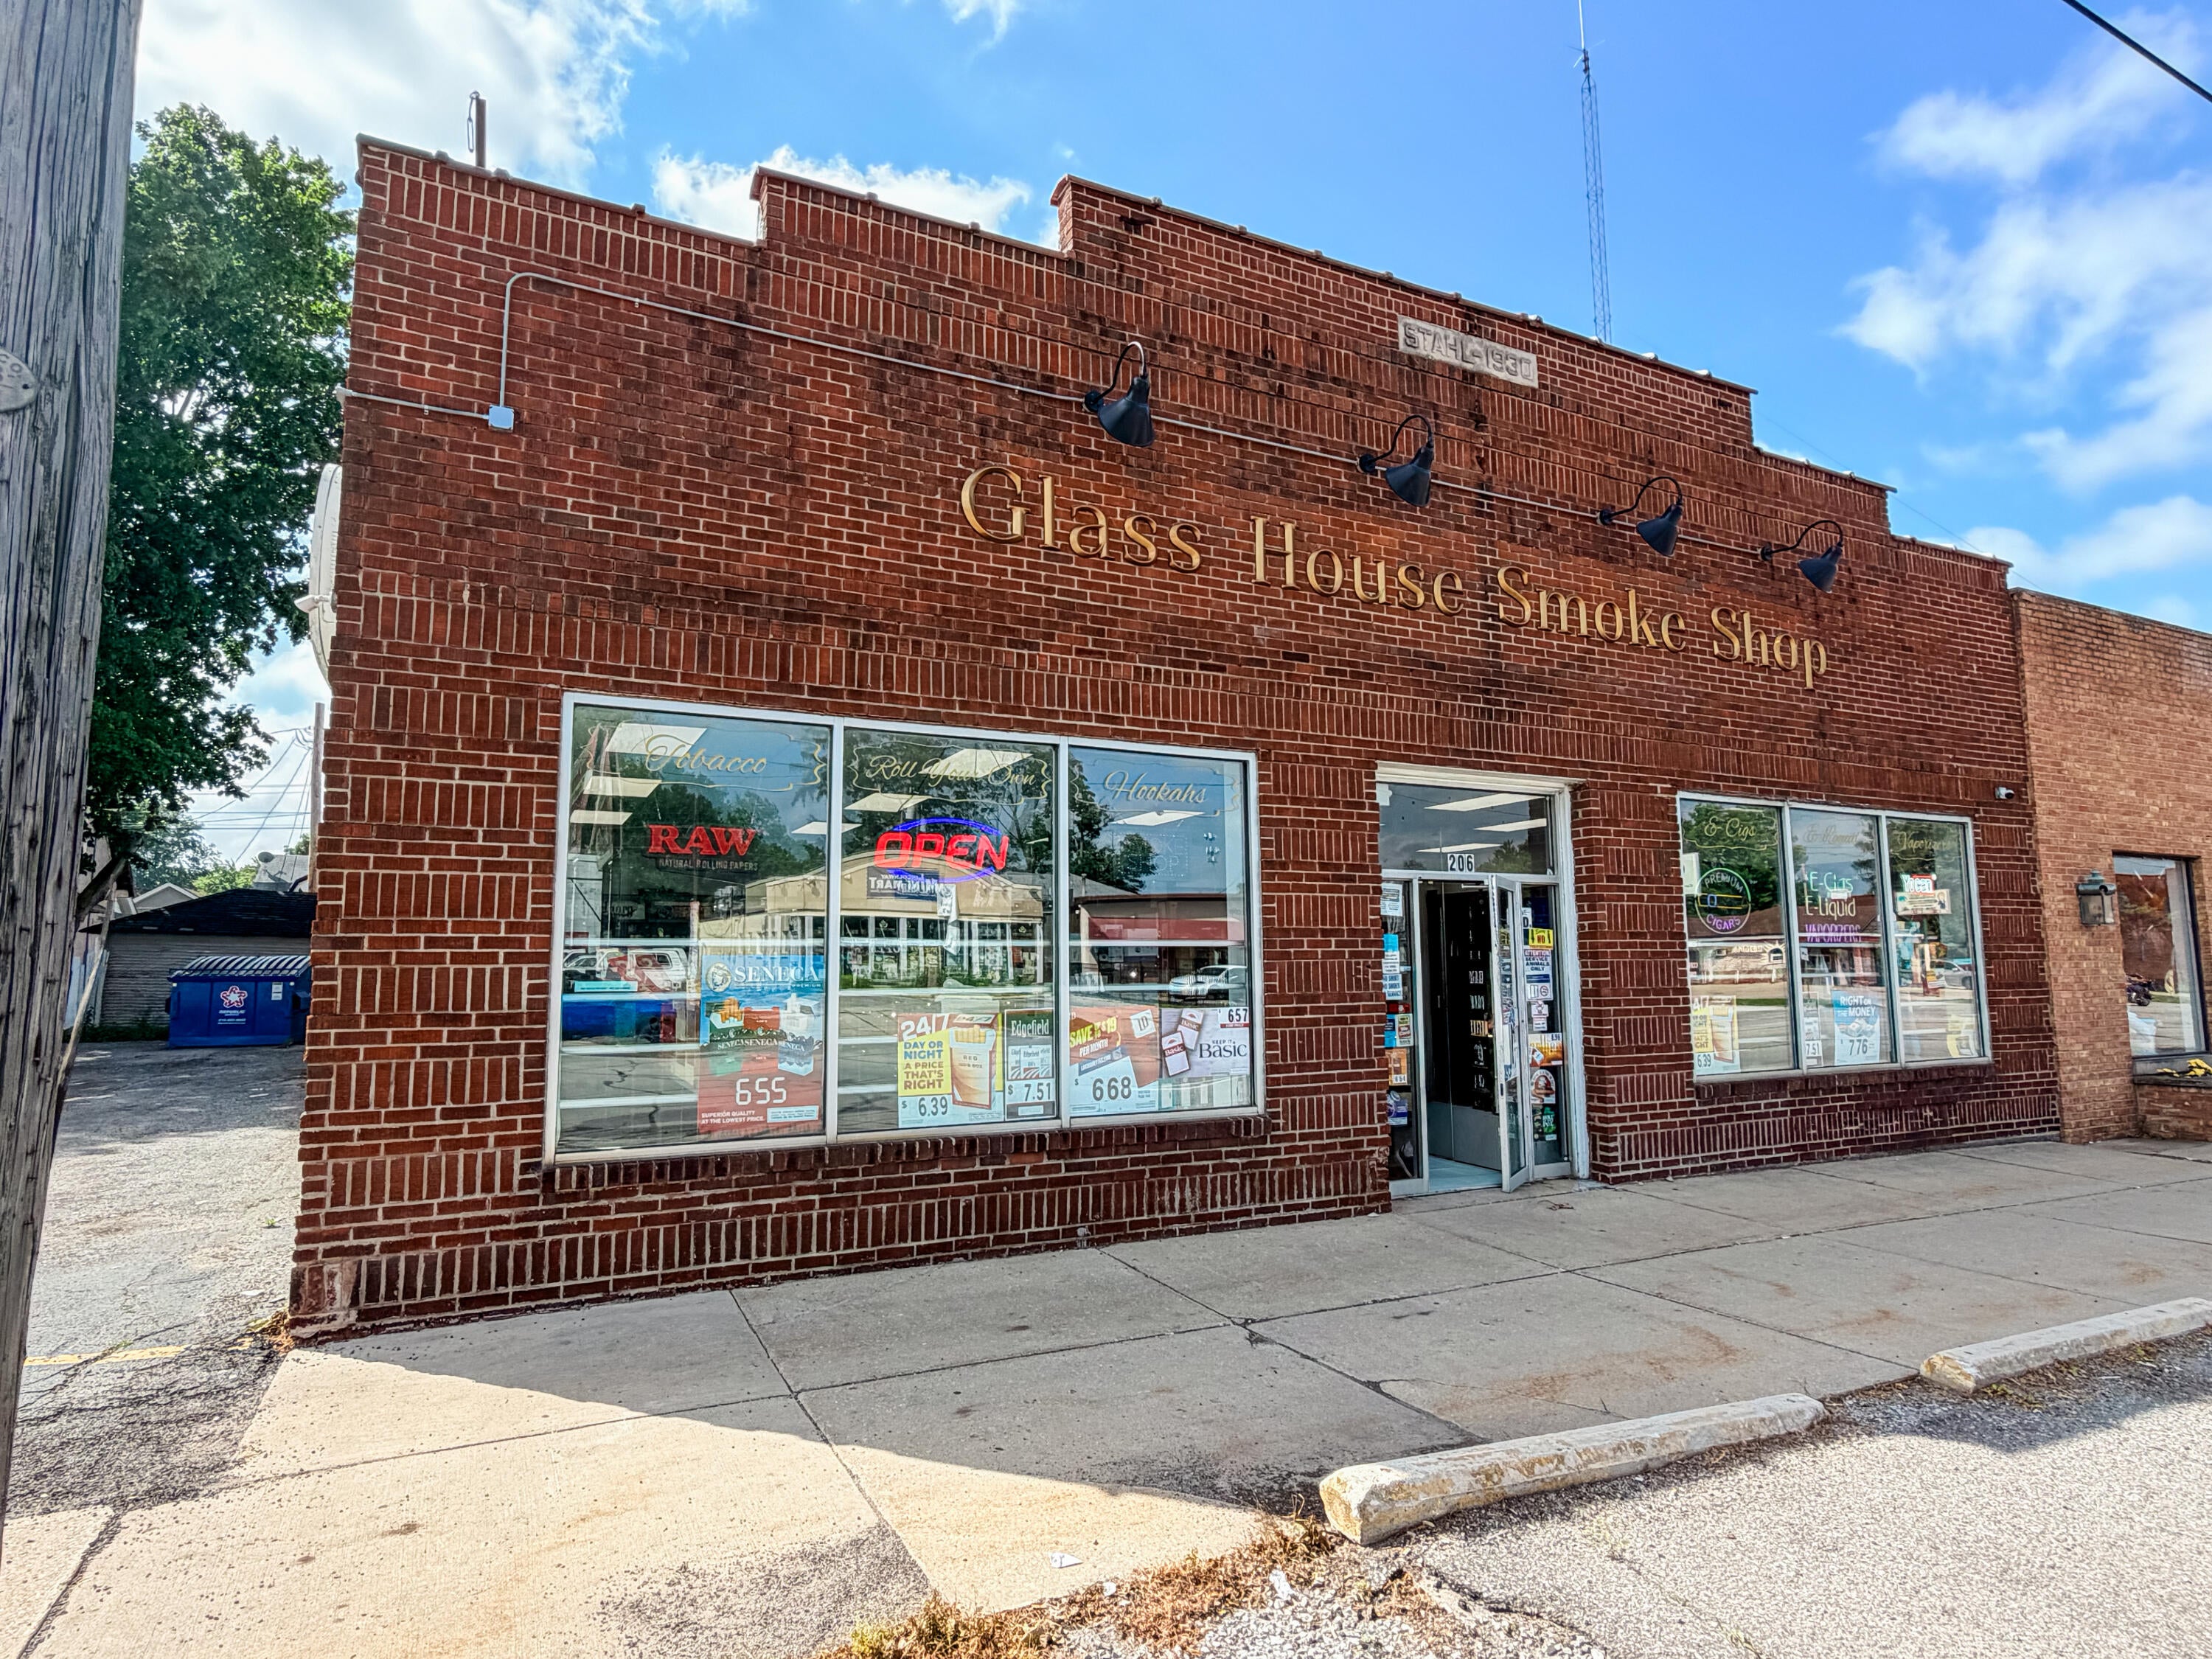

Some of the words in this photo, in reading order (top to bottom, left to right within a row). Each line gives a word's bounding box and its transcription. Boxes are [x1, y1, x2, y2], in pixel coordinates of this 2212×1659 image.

[961, 466, 1201, 571] Glass
[1251, 515, 1464, 616] House
[1497, 566, 1686, 653] Smoke
[1711, 607, 1826, 690] Shop
[646, 734, 767, 773] Tobacco
[866, 755, 917, 780] Roll
[922, 758, 979, 787] Your
[988, 764, 1036, 785] Own
[1104, 770, 1208, 804] Hookahs
[648, 824, 756, 856] RAW
[873, 832, 1009, 870] OPEN
[659, 858, 693, 868] NATURAL
[696, 860, 727, 869] ROLLING
[730, 861, 758, 871] PAPERS
[1449, 855, 1473, 872] 206
[1705, 872, 1744, 893] PREMIUM
[1806, 895, 1856, 921] E-Liquid
[1706, 914, 1741, 931] CIGARS
[734, 966, 820, 982] SENECA
[1840, 996, 1864, 1006] RIGHT
[1228, 1008, 1248, 1023] 657
[1848, 1006, 1876, 1017] MONEY
[1011, 1019, 1049, 1037] Edgefield
[1181, 1020, 1199, 1031] Basic
[744, 1038, 779, 1046] SENECA
[904, 1041, 926, 1049] DAY
[928, 1040, 943, 1048] OR
[1069, 1024, 1093, 1048] SAVE
[904, 1050, 944, 1060] NIGHT
[1165, 1046, 1184, 1055] Basic
[1199, 1041, 1248, 1059] Basic
[915, 1061, 944, 1069] PRICE
[905, 1070, 944, 1079] THAT'S
[736, 1077, 787, 1105] 655
[904, 1079, 944, 1091] RIGHT
[1008, 1085, 1013, 1095] $
[1024, 1082, 1051, 1102] 7.51
[1093, 1077, 1131, 1102] 668
[919, 1096, 948, 1116] 6.39
